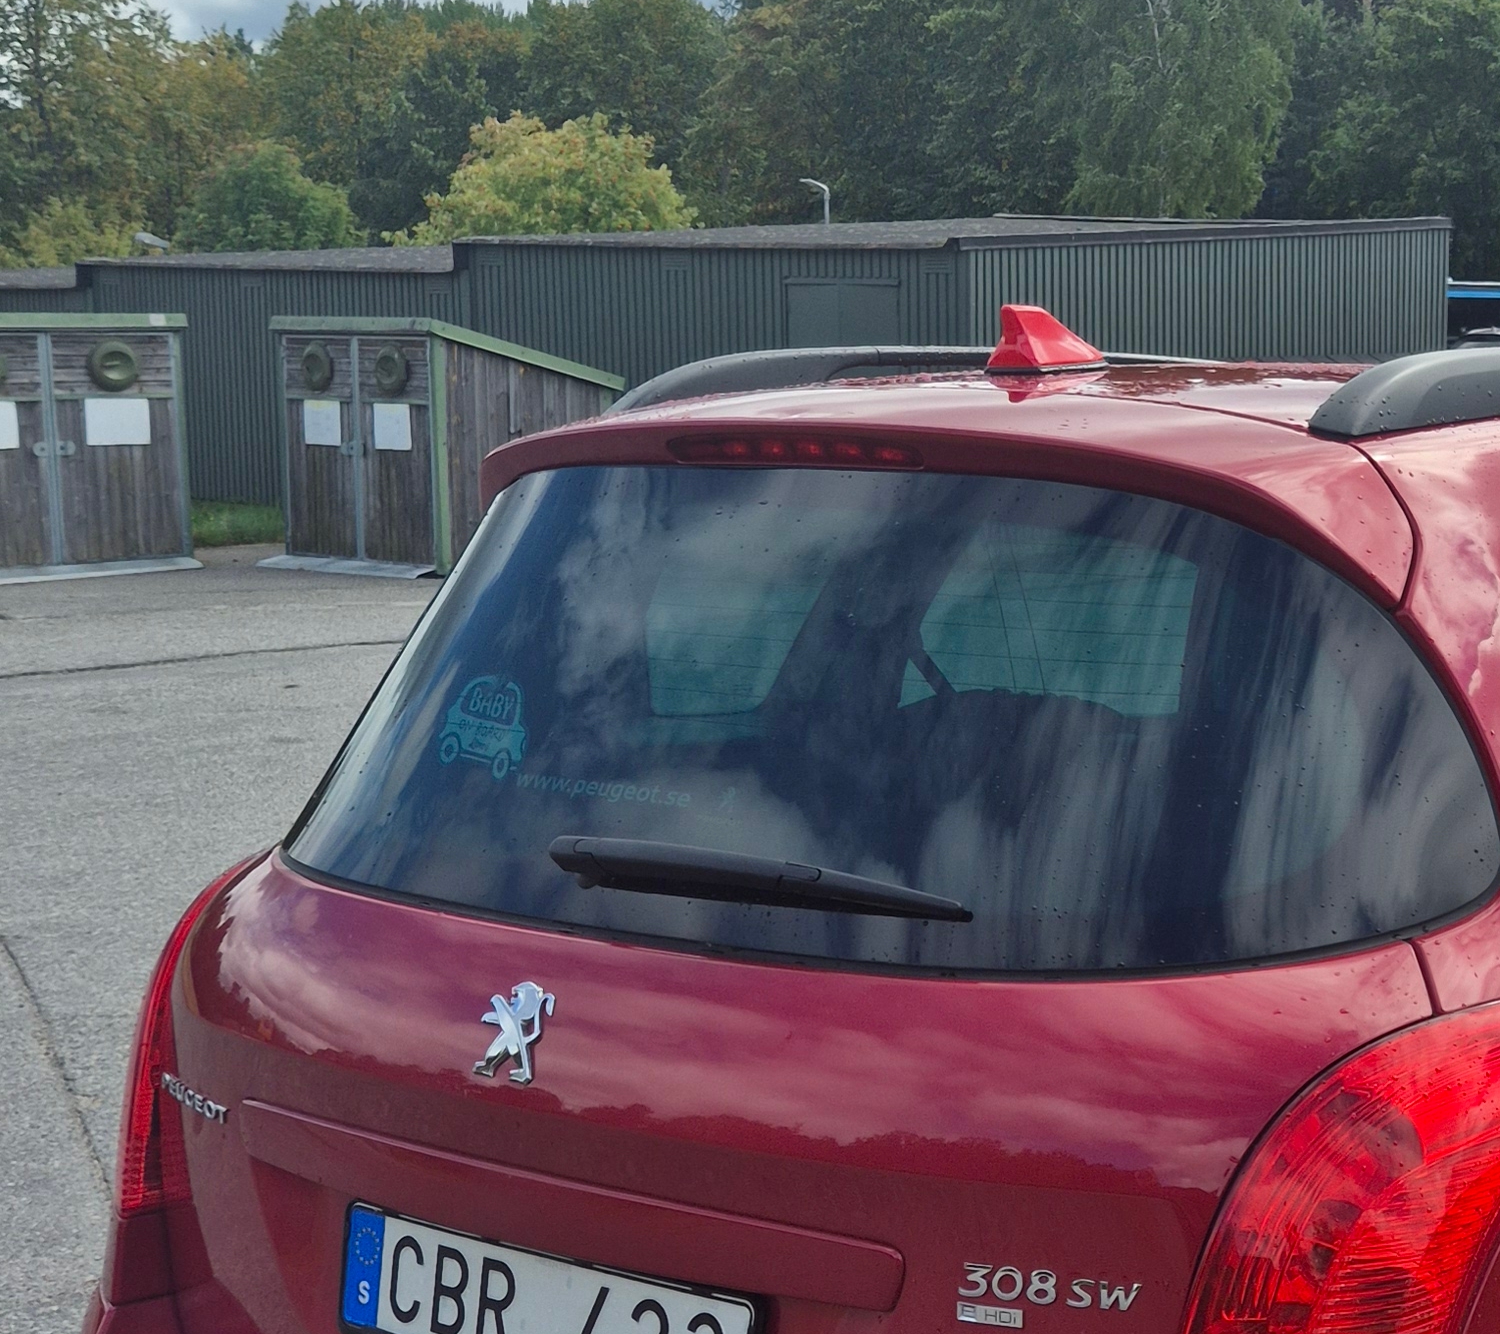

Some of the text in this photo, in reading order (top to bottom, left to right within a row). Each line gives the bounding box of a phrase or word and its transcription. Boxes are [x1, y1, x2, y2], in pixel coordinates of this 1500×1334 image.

[469, 688, 514, 720] BABY
[516, 773, 691, 807] www.peugeot.se
[358, 1280, 370, 1305] S
[958, 1262, 1142, 1311] 308 SW
